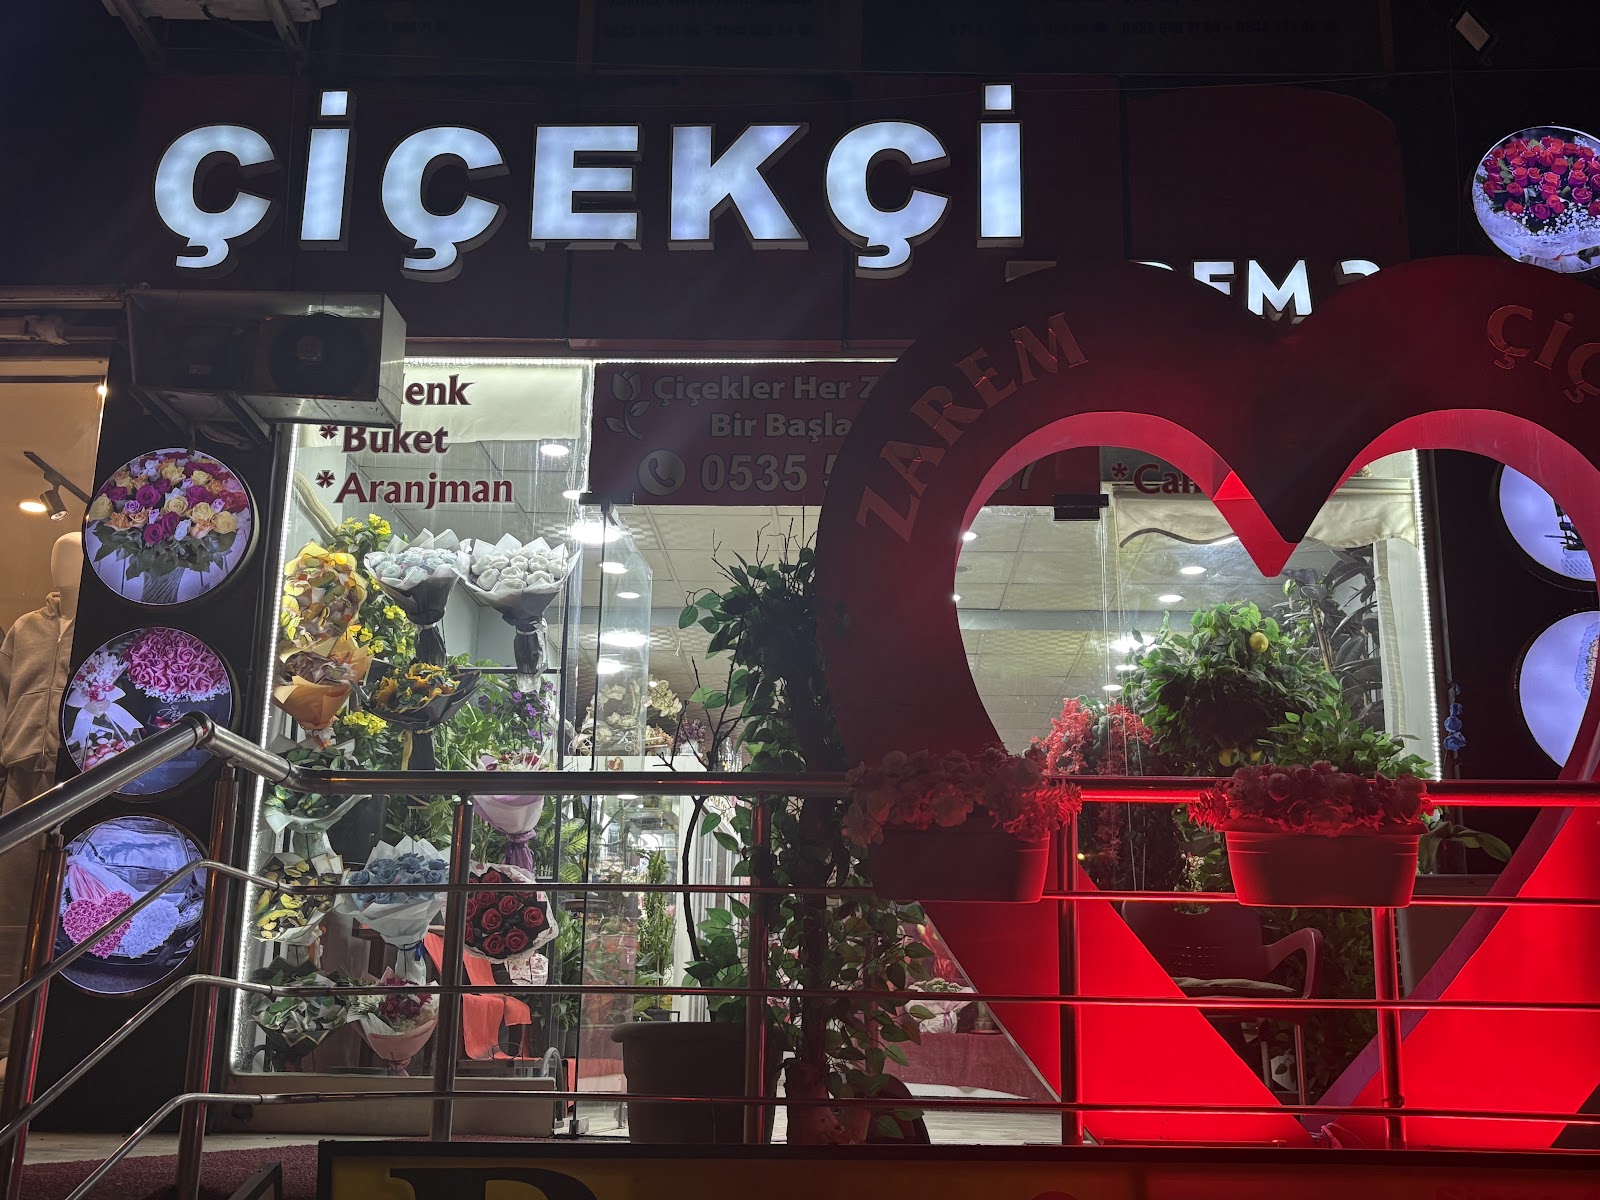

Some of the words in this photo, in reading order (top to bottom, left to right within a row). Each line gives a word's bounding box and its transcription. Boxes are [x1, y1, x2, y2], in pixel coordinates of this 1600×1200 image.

[153, 84, 1024, 271] ÇİÇEKÇİ
[652, 375, 786, 407] Çiçekler
[793, 375, 852, 400] Her
[710, 412, 757, 438] Bir
[856, 312, 1088, 543] ZAREM
[700, 453, 808, 493] 0535
